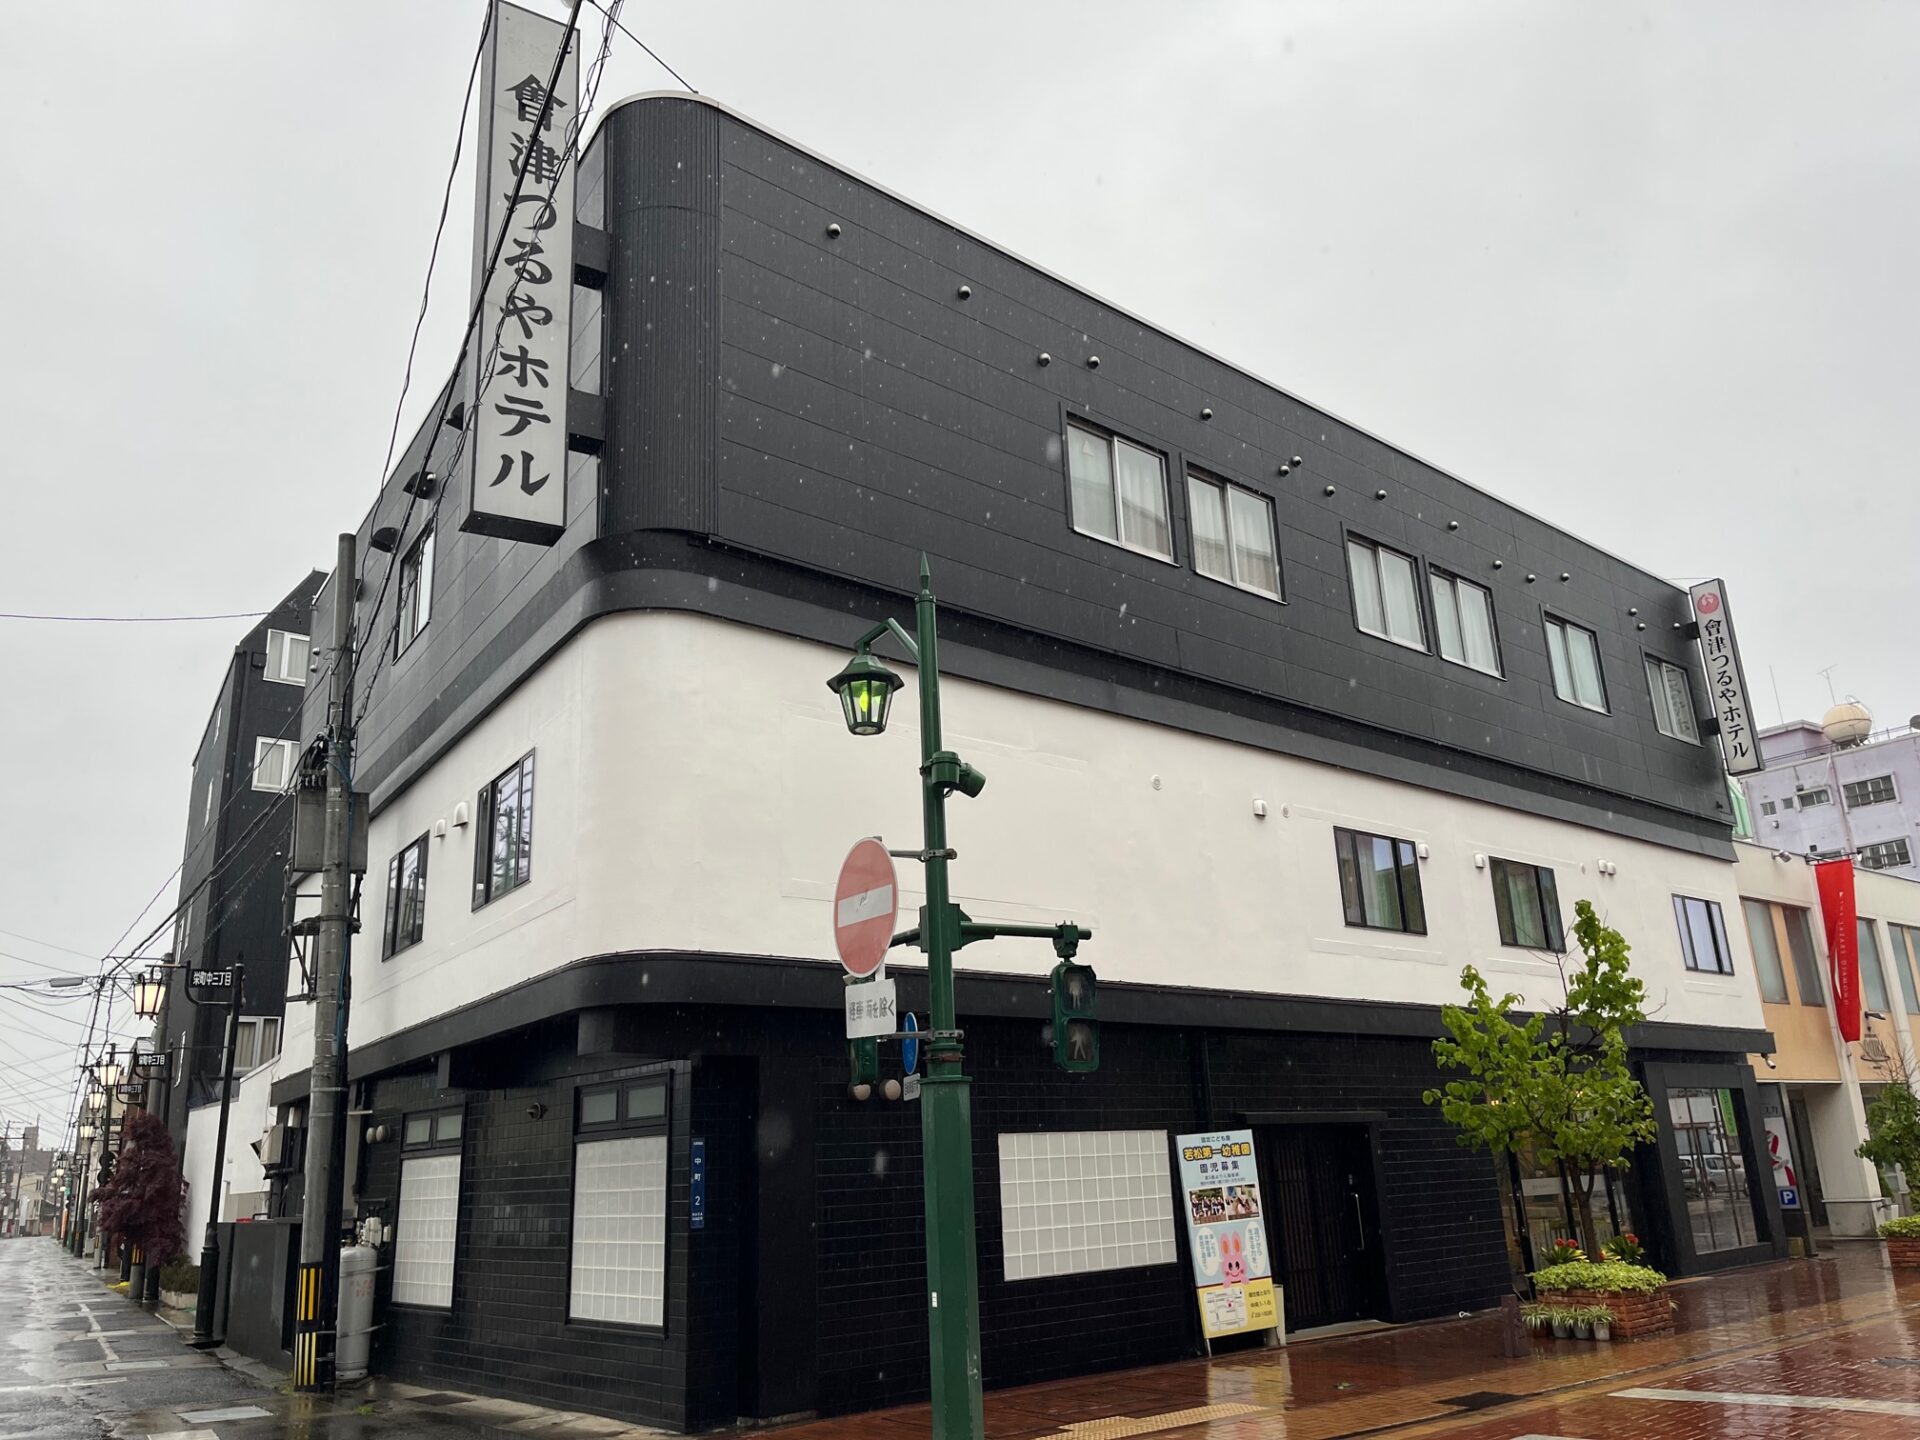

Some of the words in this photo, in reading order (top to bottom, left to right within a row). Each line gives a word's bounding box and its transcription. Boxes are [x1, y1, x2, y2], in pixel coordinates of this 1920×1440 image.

[490, 73, 567, 496] 會津つるやホテル
[1704, 619, 1749, 760] 會津つるやホテル
[193, 971, 232, 986] 栄町中三丁目
[1183, 1142, 1252, 1161] 若松第一幼稚園
[1200, 1161, 1240, 1174] 園児募集
[695, 1195, 701, 1206] 2
[1783, 1191, 1793, 1204] P
